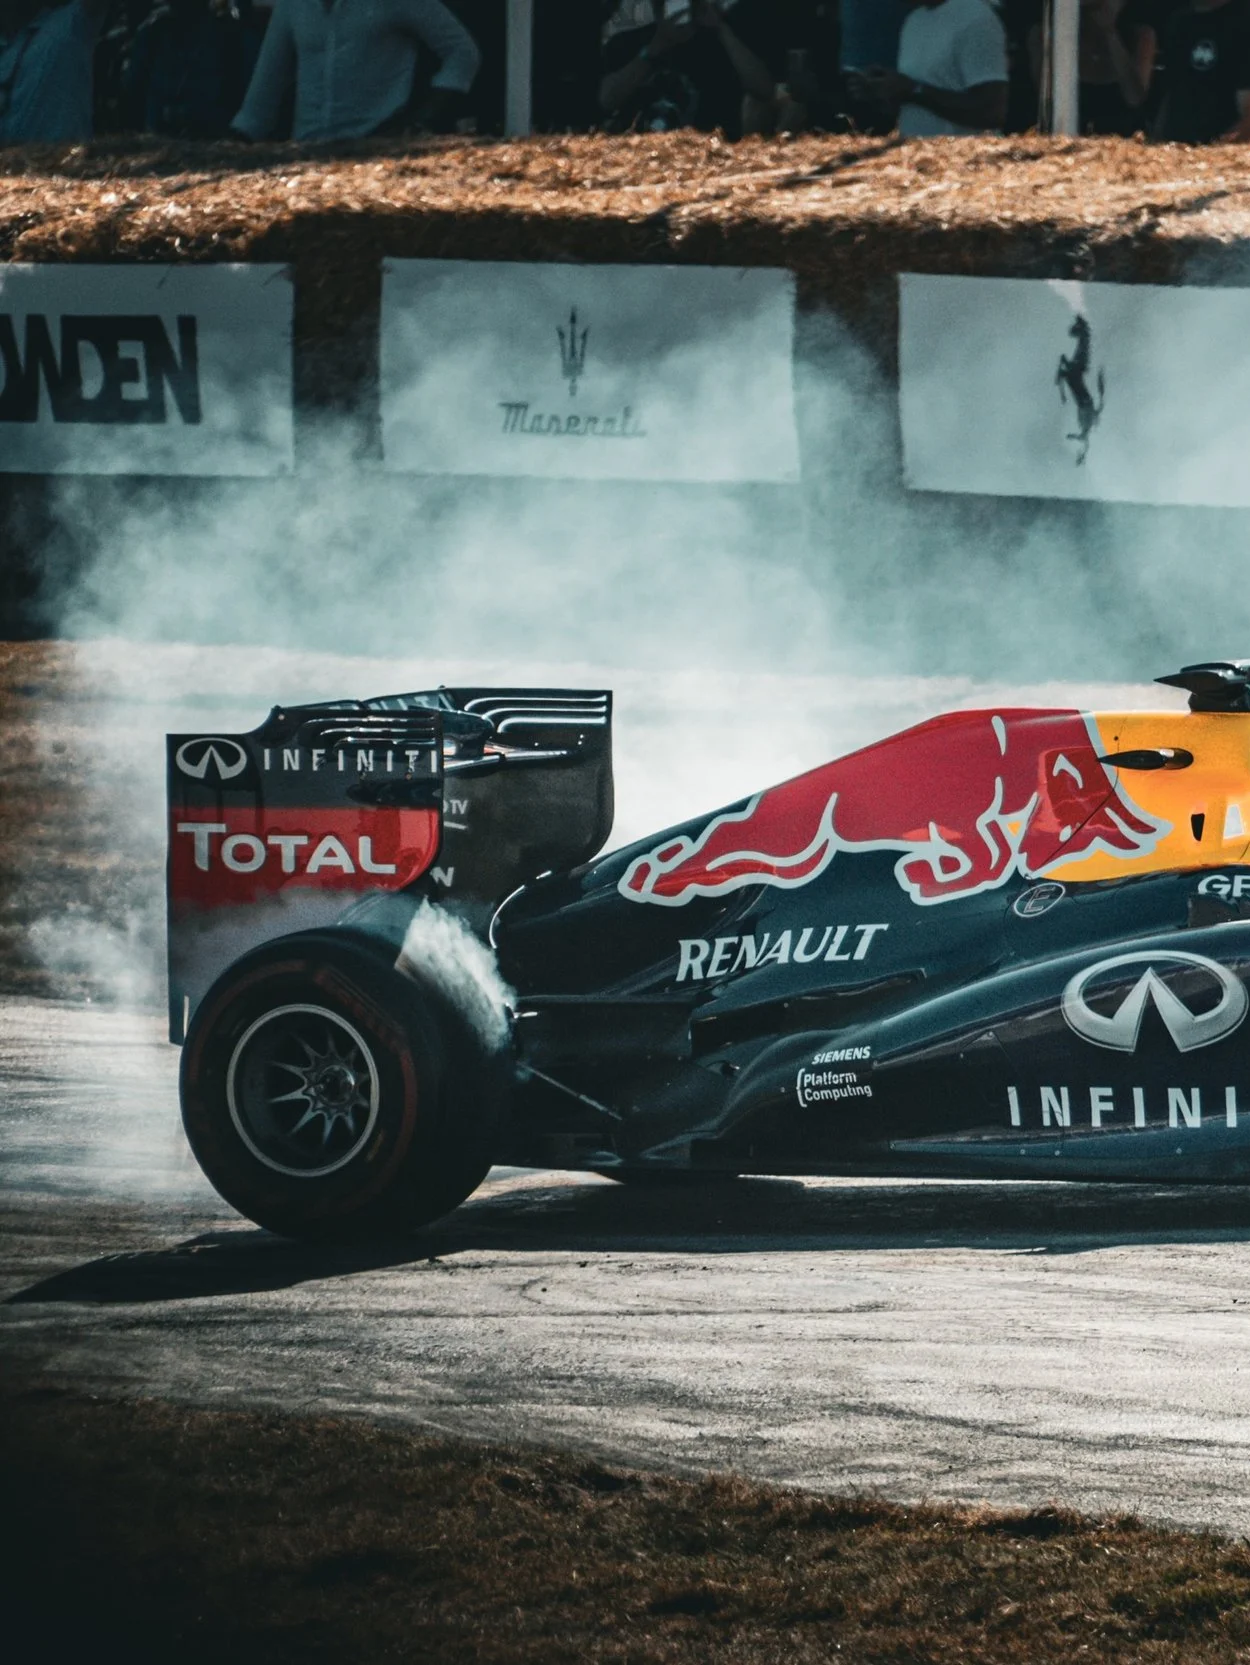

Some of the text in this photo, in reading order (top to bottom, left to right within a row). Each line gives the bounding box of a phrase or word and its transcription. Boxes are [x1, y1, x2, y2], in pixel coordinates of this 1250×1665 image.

[264, 748, 438, 773] INFINITI
[177, 822, 396, 873] TOTAL
[676, 923, 890, 982] RENAULT
[812, 1046, 871, 1064] SIEMENS
[804, 1071, 857, 1087] Platform
[804, 1085, 873, 1101] Computing
